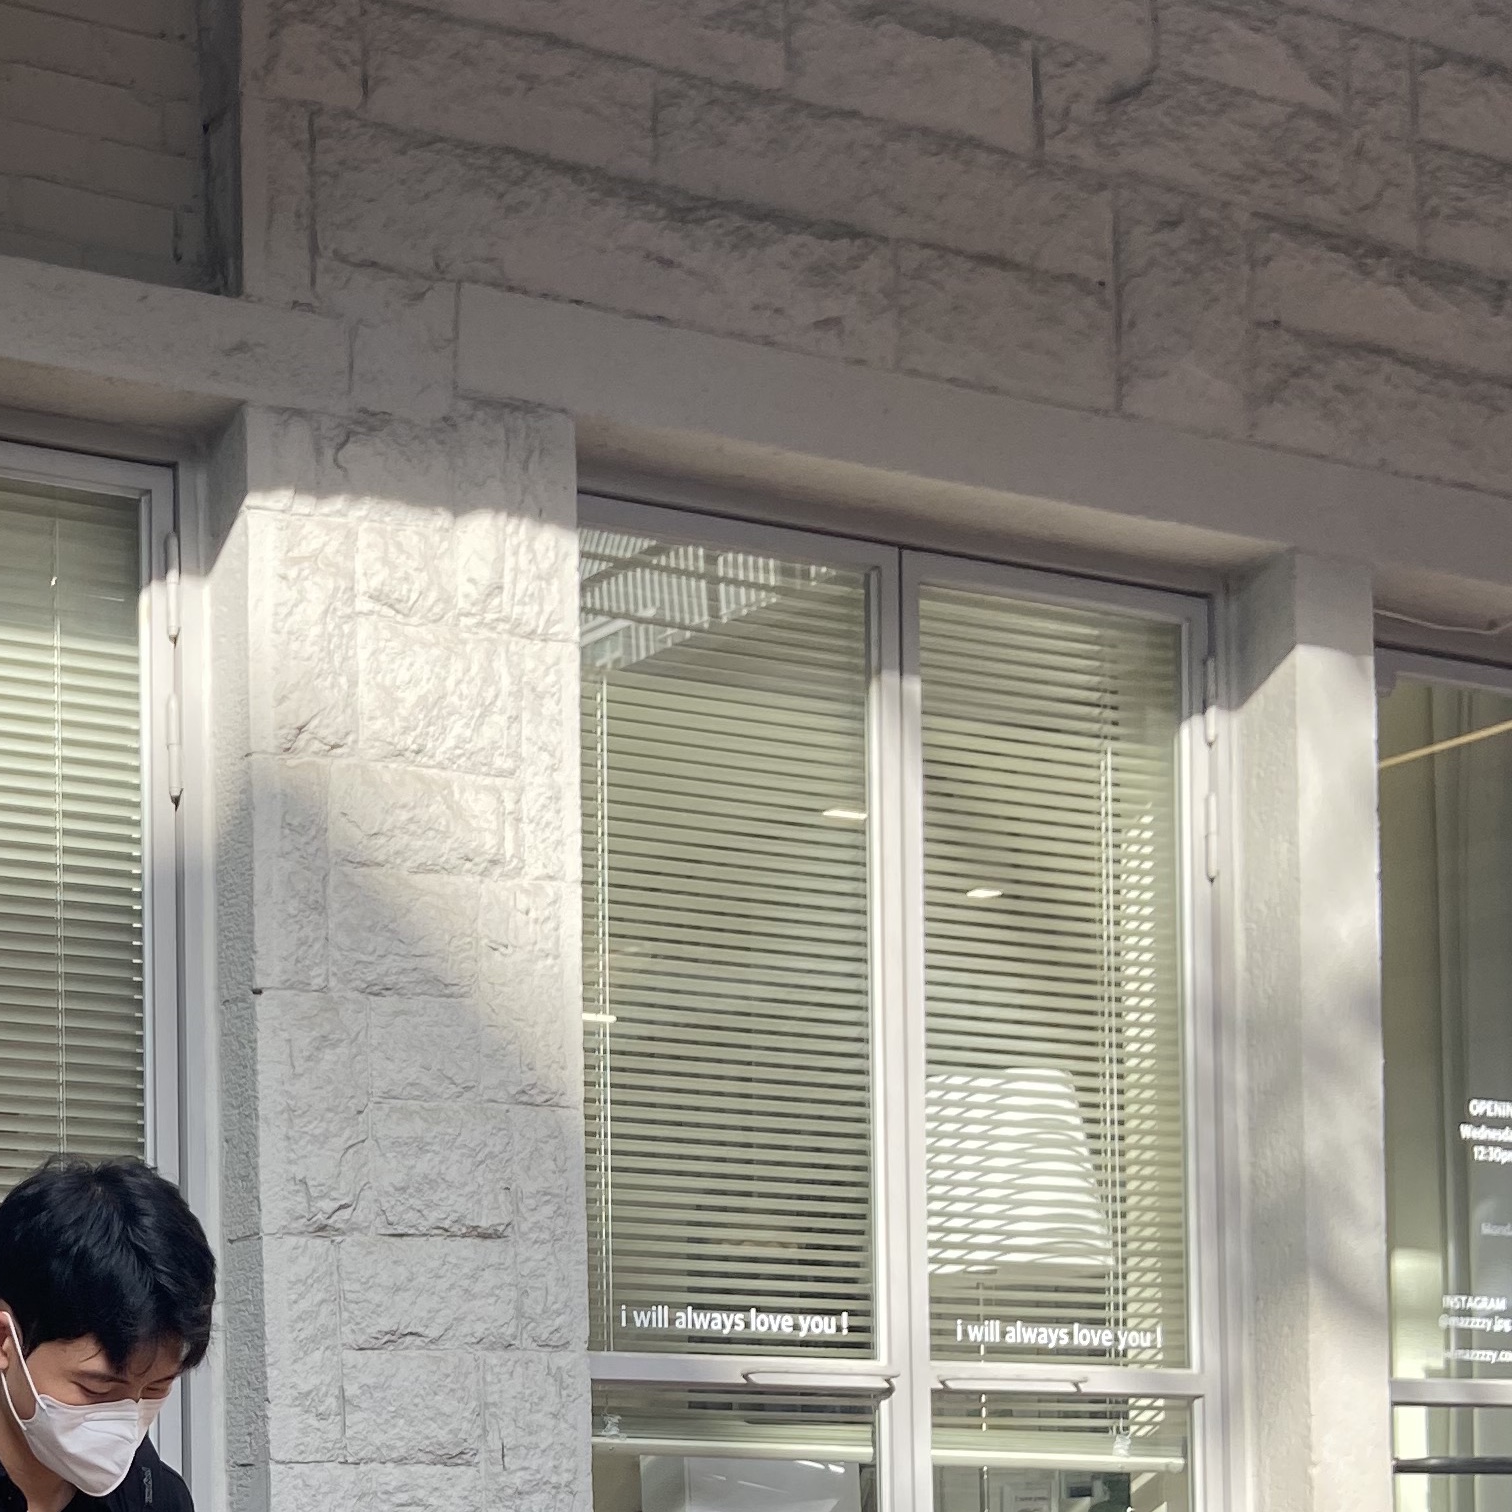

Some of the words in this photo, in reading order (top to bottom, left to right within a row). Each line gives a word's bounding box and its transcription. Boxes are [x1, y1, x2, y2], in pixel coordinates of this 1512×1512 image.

[1442, 1294, 1507, 1312] INSTAGRAM
[620, 1304, 627, 1328] i
[632, 1304, 669, 1329] will
[674, 1305, 745, 1335] always
[749, 1307, 794, 1332] love
[956, 1318, 963, 1342] i
[966, 1319, 1001, 1343] will
[1004, 1320, 1070, 1349] always
[1072, 1322, 1114, 1346] love
